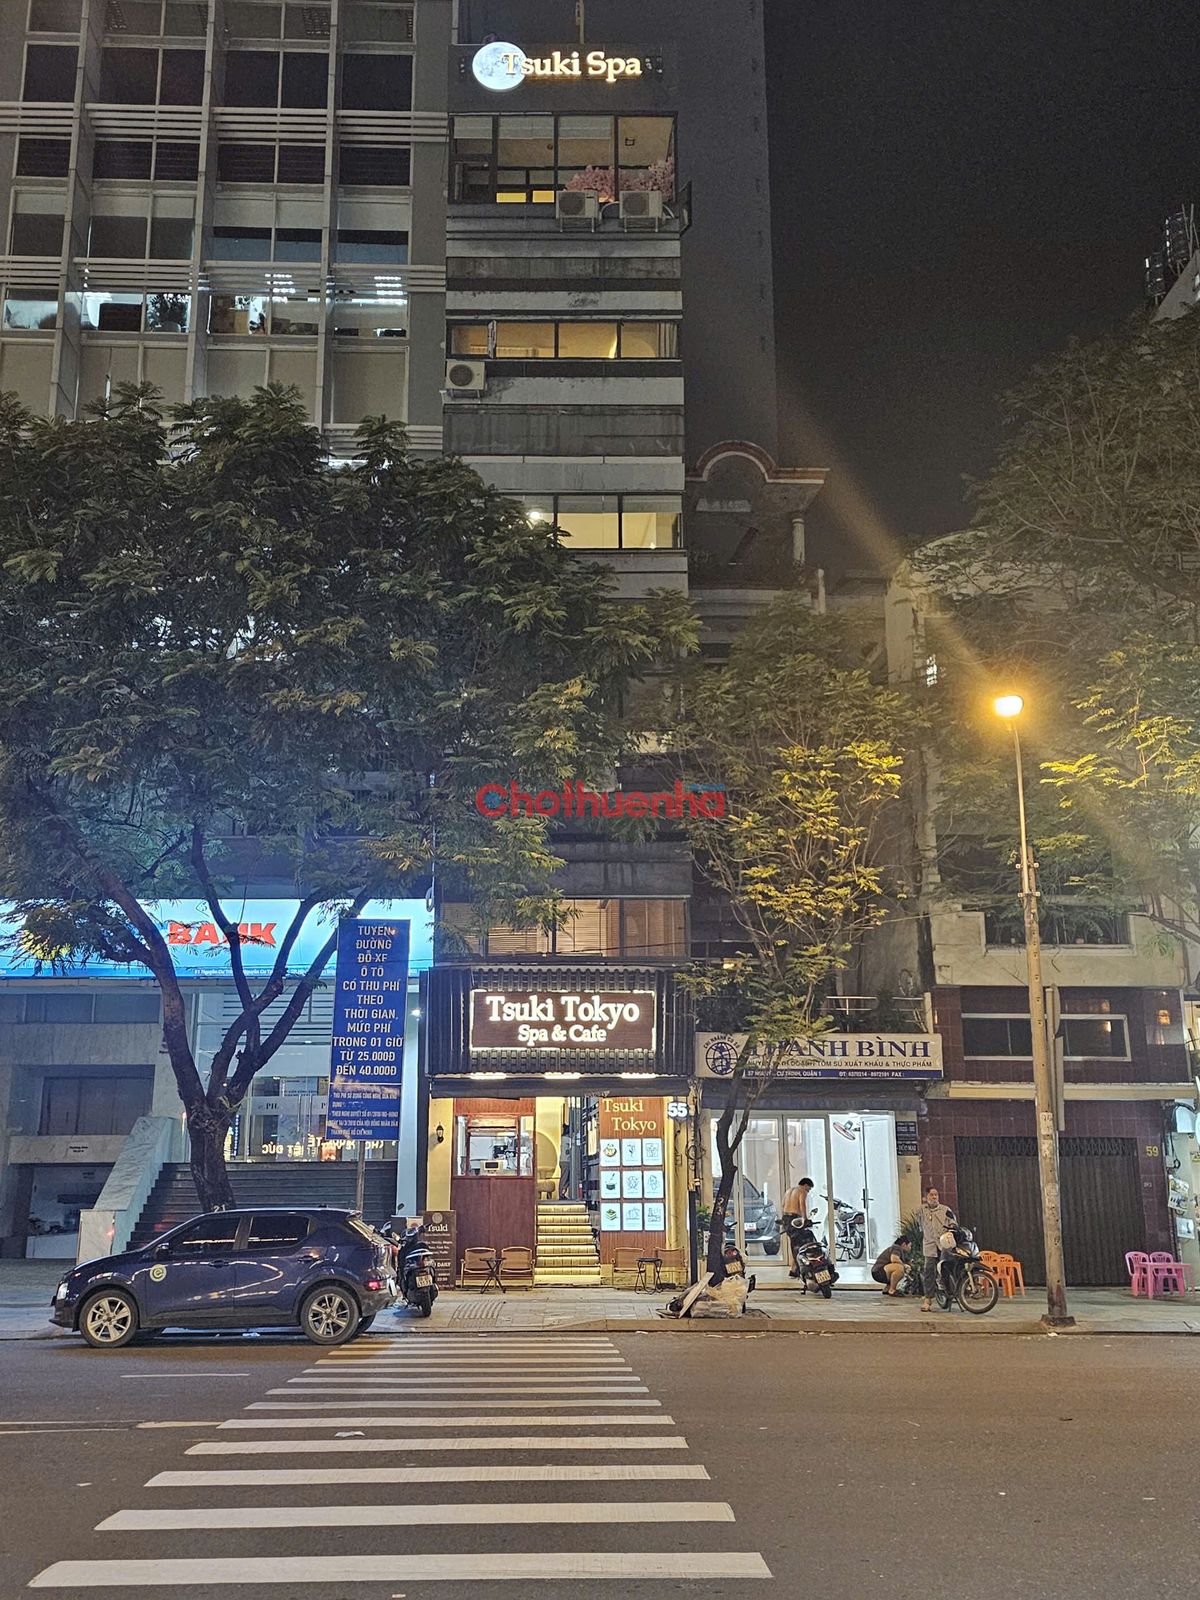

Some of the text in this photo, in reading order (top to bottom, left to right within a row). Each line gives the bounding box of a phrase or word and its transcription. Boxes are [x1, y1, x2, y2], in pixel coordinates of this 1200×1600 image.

[503, 51, 643, 82] Tsuki Spa
[355, 937, 392, 950] ĐƯỜNG
[342, 978, 401, 991] CÓ THU PHÍ
[357, 995, 384, 1005] THEO
[344, 1006, 368, 1019] THỜI
[485, 994, 640, 1030] Tsuki Tokyo
[347, 1020, 392, 1033] MỨC PHÍ
[333, 1034, 404, 1047] TRONG 01 GIỜ
[517, 1024, 607, 1046] Spa & Cafe
[855, 1036, 931, 1057] BÌNH
[340, 1048, 396, 1061] TỪ 25.000Đ
[336, 1062, 397, 1076] ĐẾN 40.000Đ
[602, 1099, 643, 1113] Tsuki
[667, 1102, 688, 1118] 55
[611, 1117, 657, 1135] Tokyo
[1146, 1146, 1159, 1157] 59
